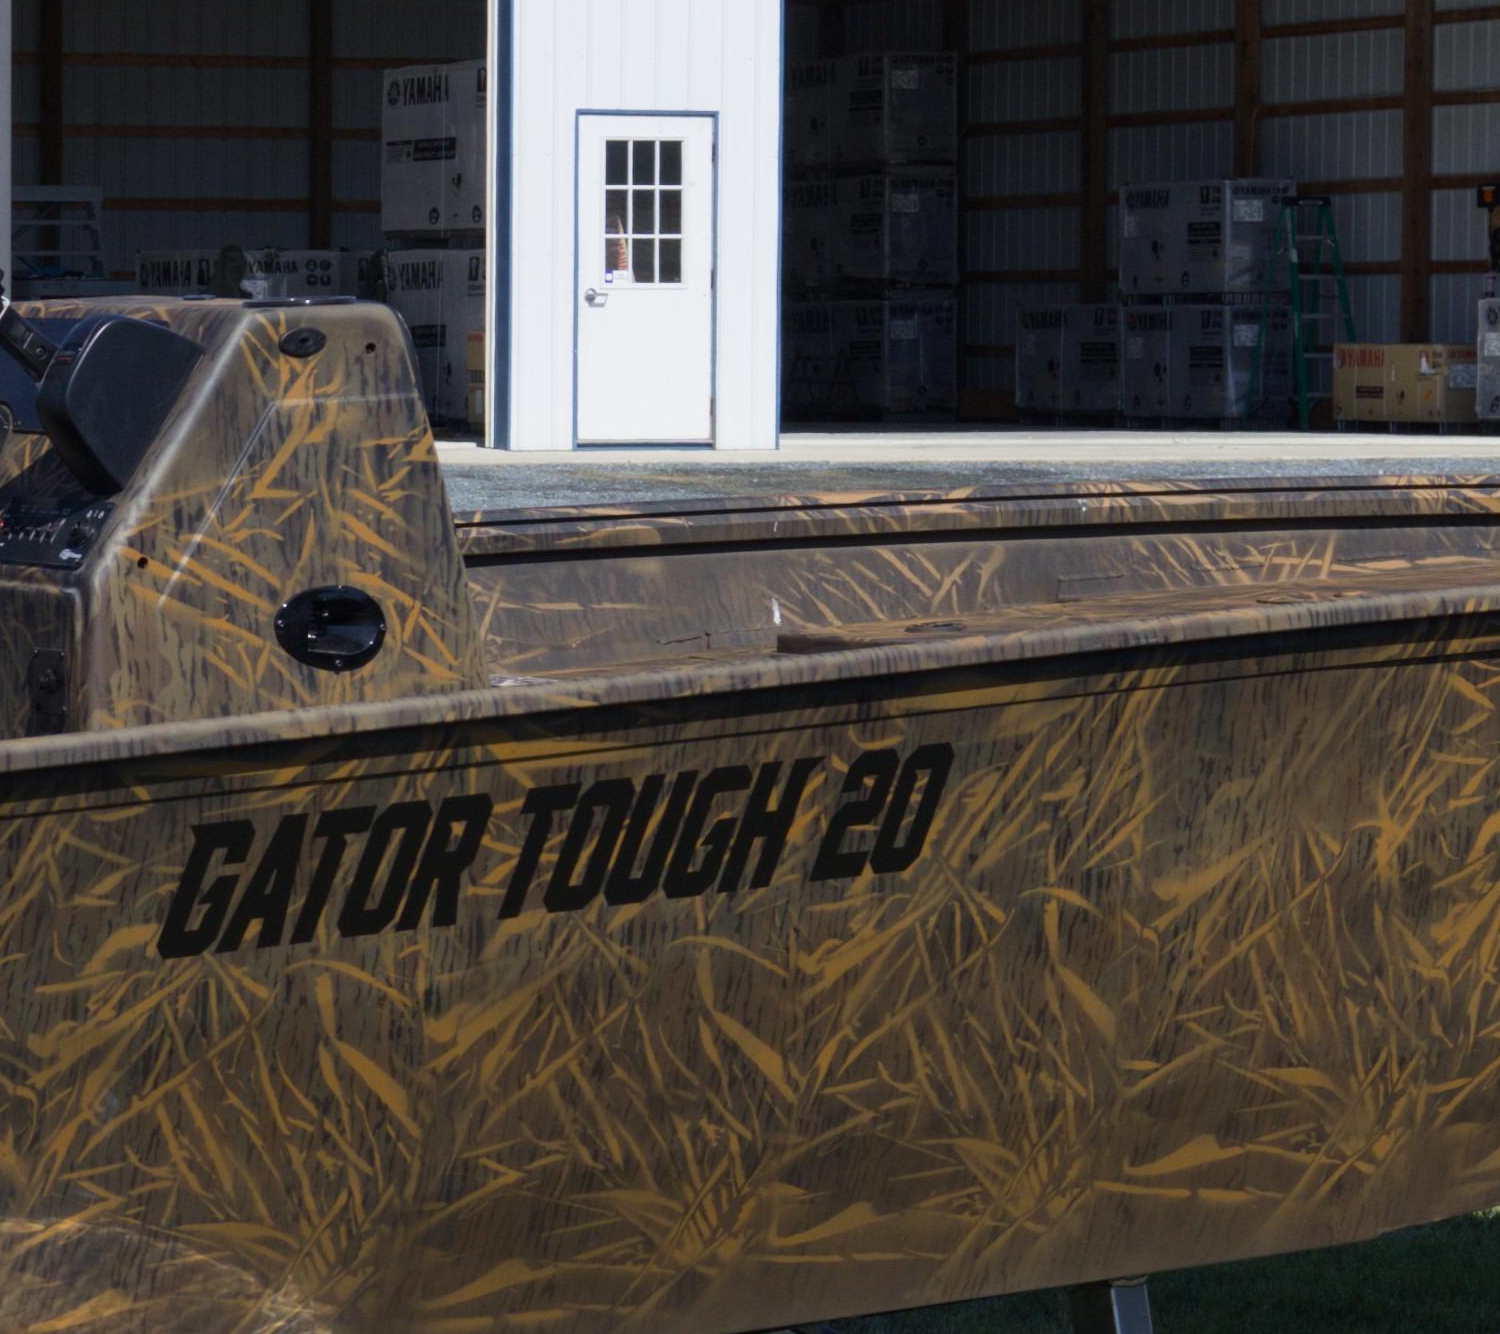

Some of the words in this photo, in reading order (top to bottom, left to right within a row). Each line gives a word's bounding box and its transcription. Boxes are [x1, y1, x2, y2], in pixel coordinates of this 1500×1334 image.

[157, 793, 492, 959] GATOR
[498, 756, 827, 920] TOUGH
[811, 742, 954, 882] 20
